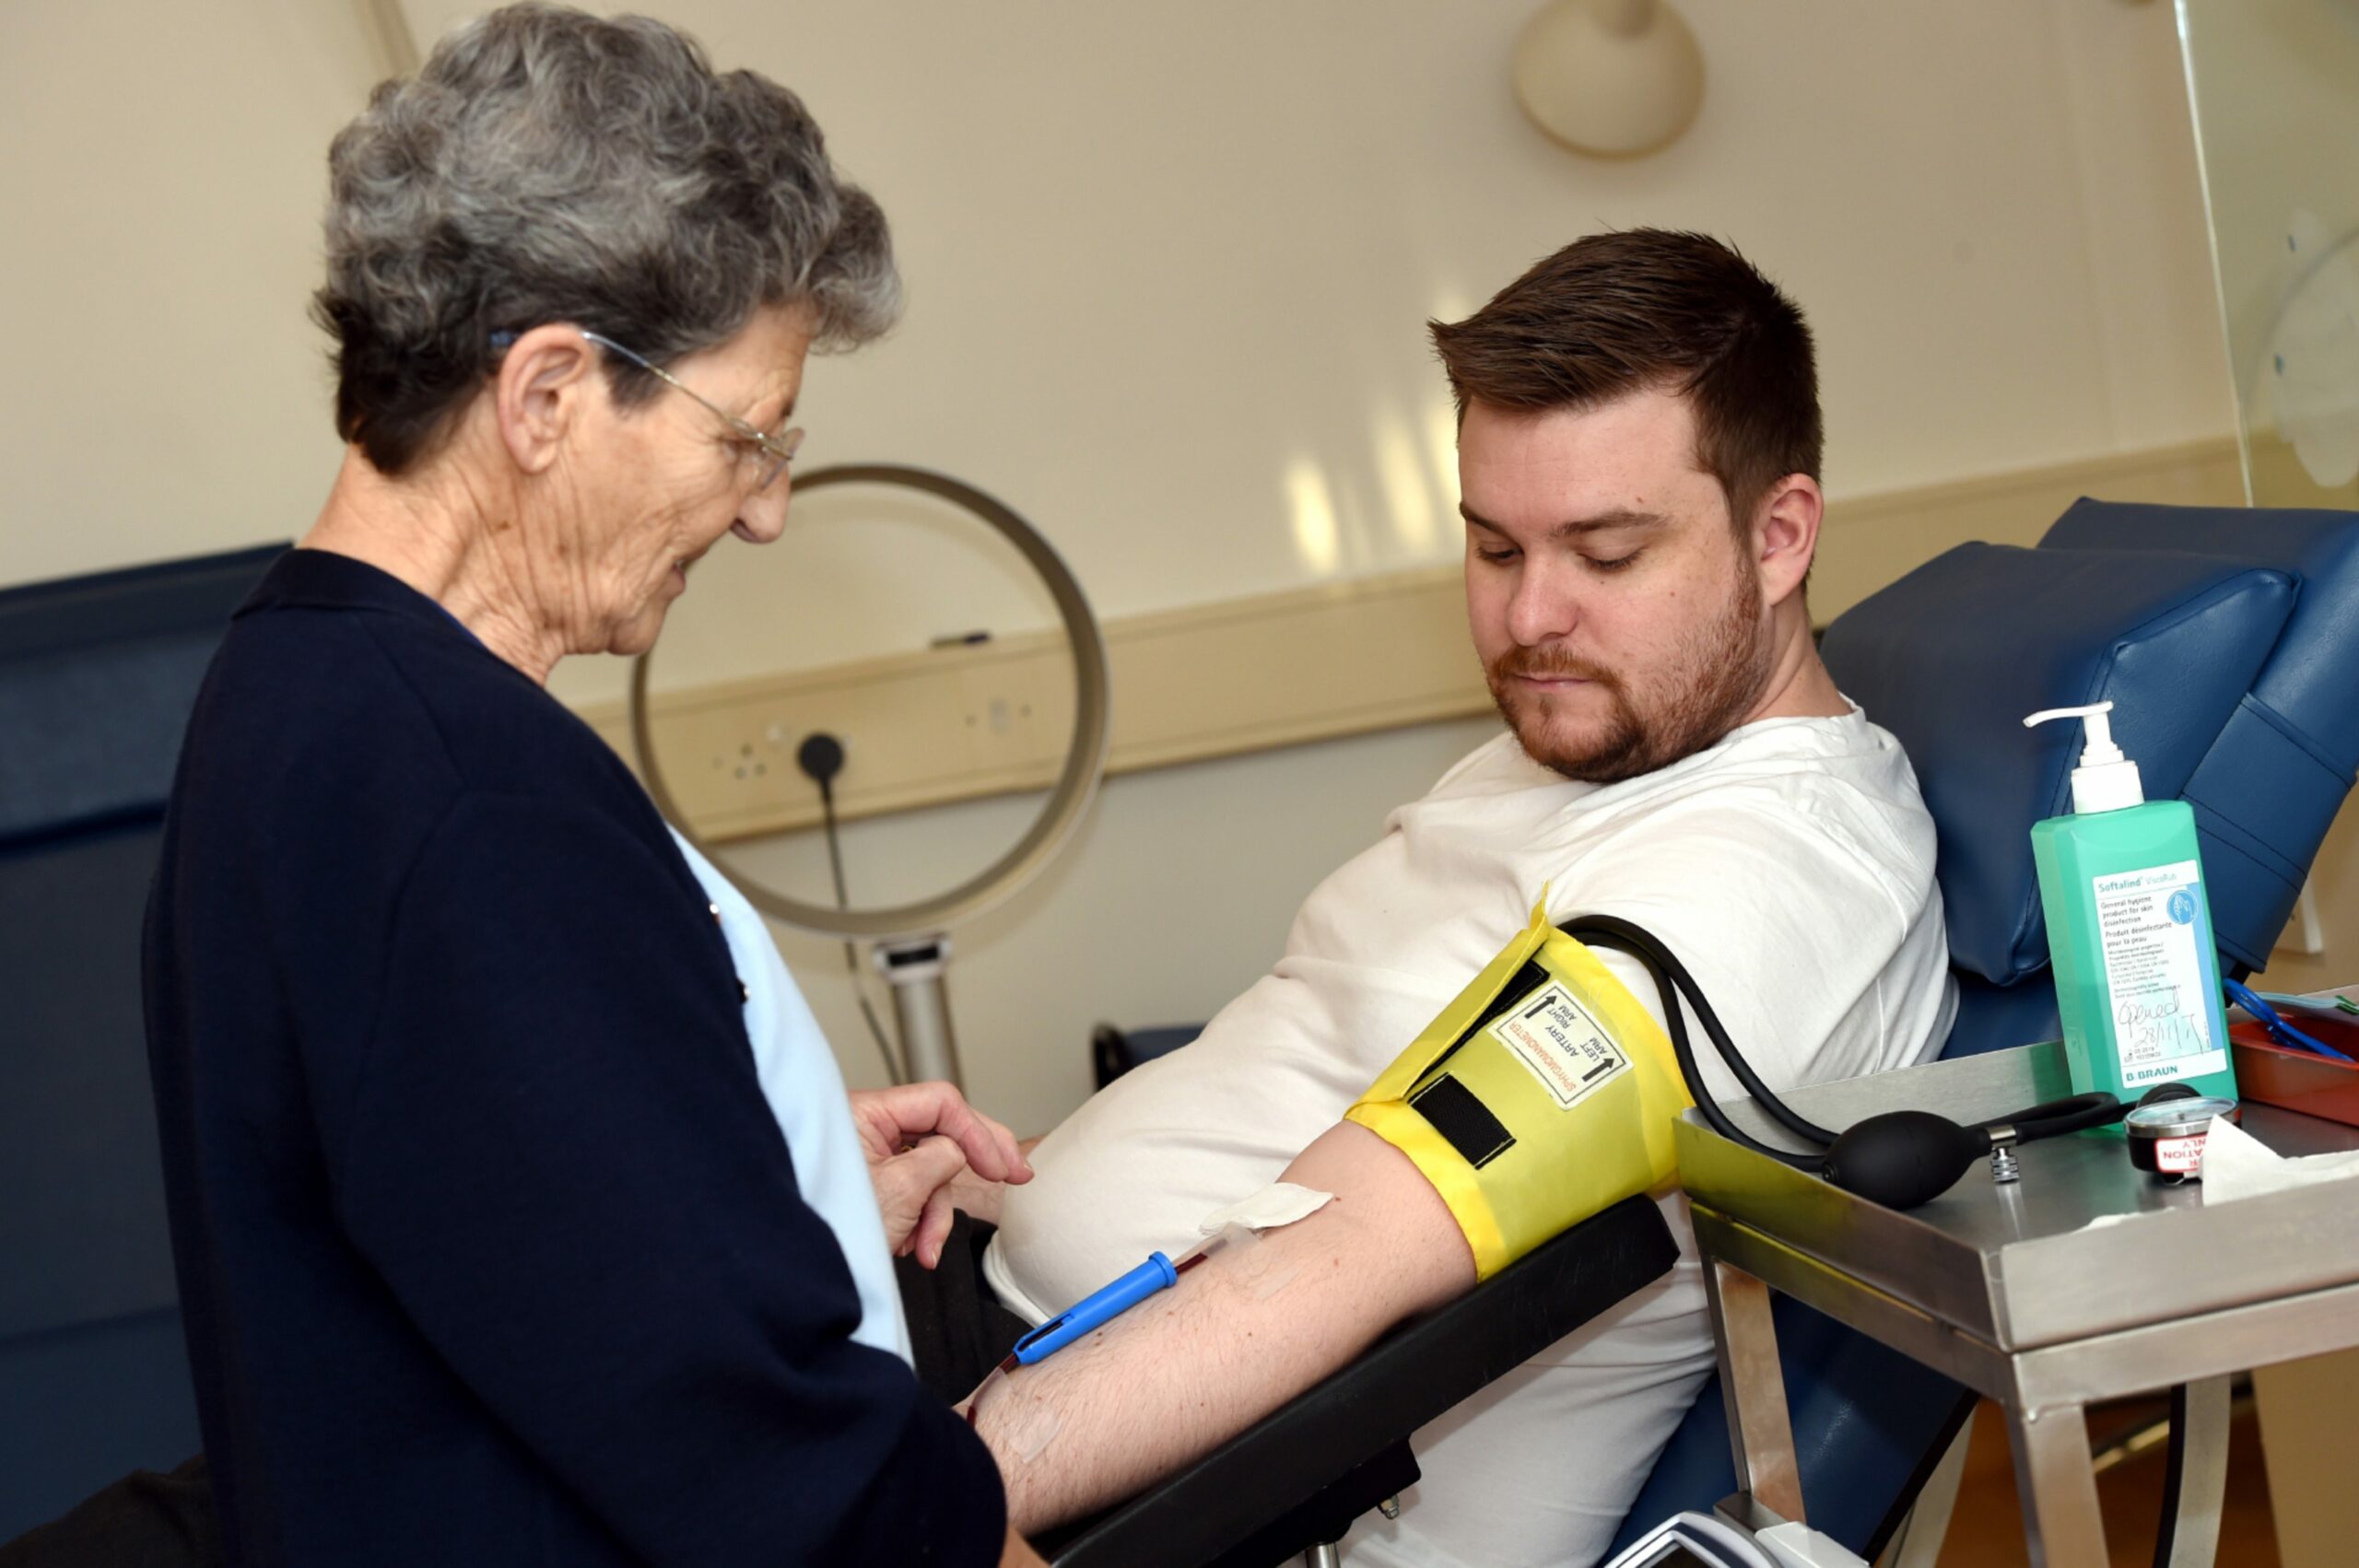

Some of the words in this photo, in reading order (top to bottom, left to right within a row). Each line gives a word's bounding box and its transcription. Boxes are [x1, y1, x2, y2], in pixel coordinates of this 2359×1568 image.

[2103, 909, 2127, 919] product
[1547, 1009, 1571, 1029] RIGHT
[1558, 1004, 1577, 1021] ARM
[1545, 1024, 1579, 1057] ARTERY
[1590, 1037, 1607, 1054] ARM
[1509, 1023, 1577, 1092] SPHYGMOMANOMETER
[1579, 1044, 1600, 1061] LEFT
[2138, 1066, 2178, 1080] BRAUN
[2183, 1139, 2206, 1148] NLY
[2164, 1149, 2202, 1159] ATION
